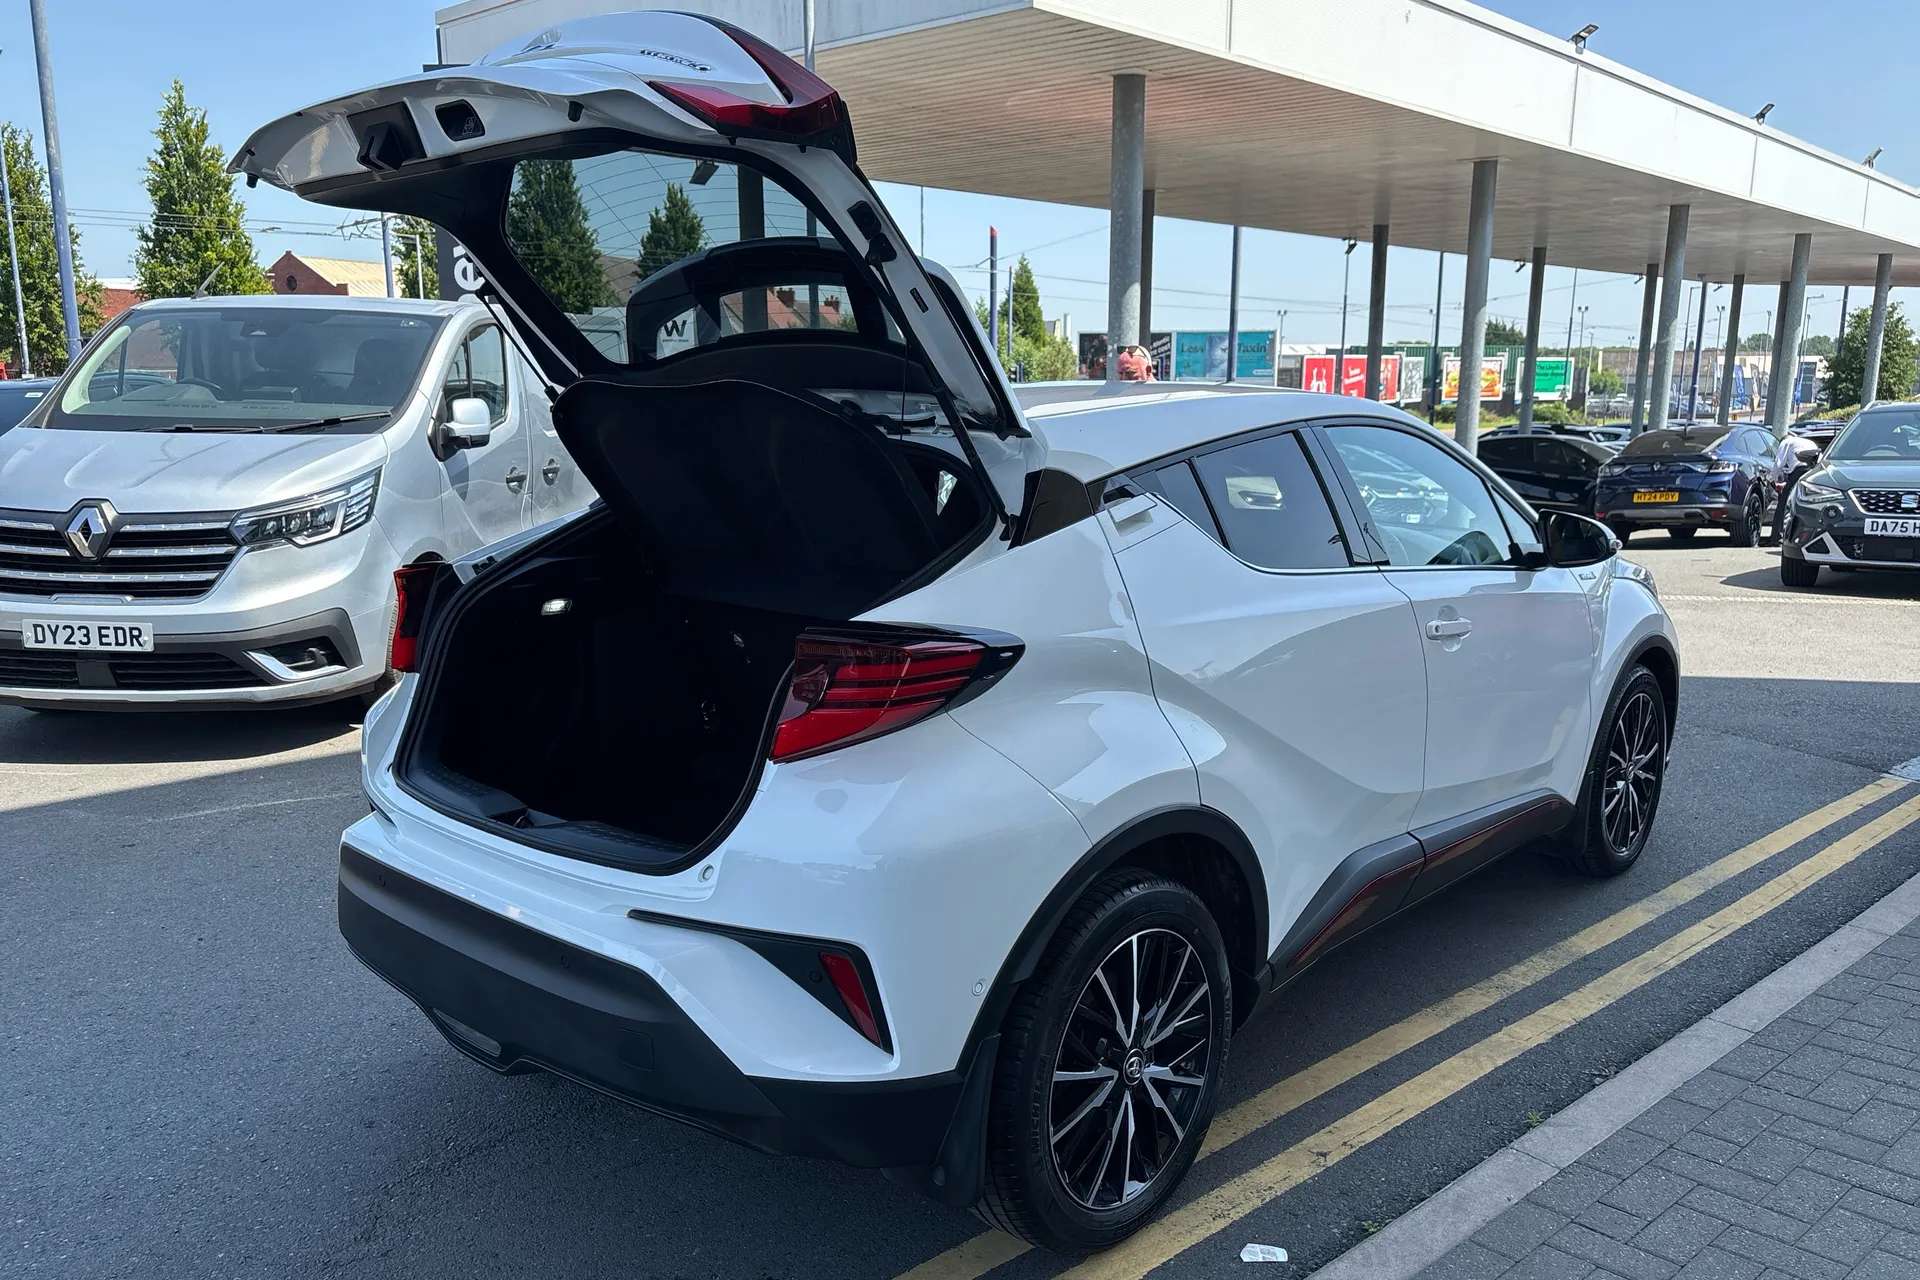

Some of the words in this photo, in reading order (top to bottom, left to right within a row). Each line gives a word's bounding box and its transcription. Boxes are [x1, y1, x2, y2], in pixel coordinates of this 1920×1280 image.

[1870, 520, 1909, 533] DA75
[32, 623, 91, 646] DY23
[97, 625, 144, 647] EDR
